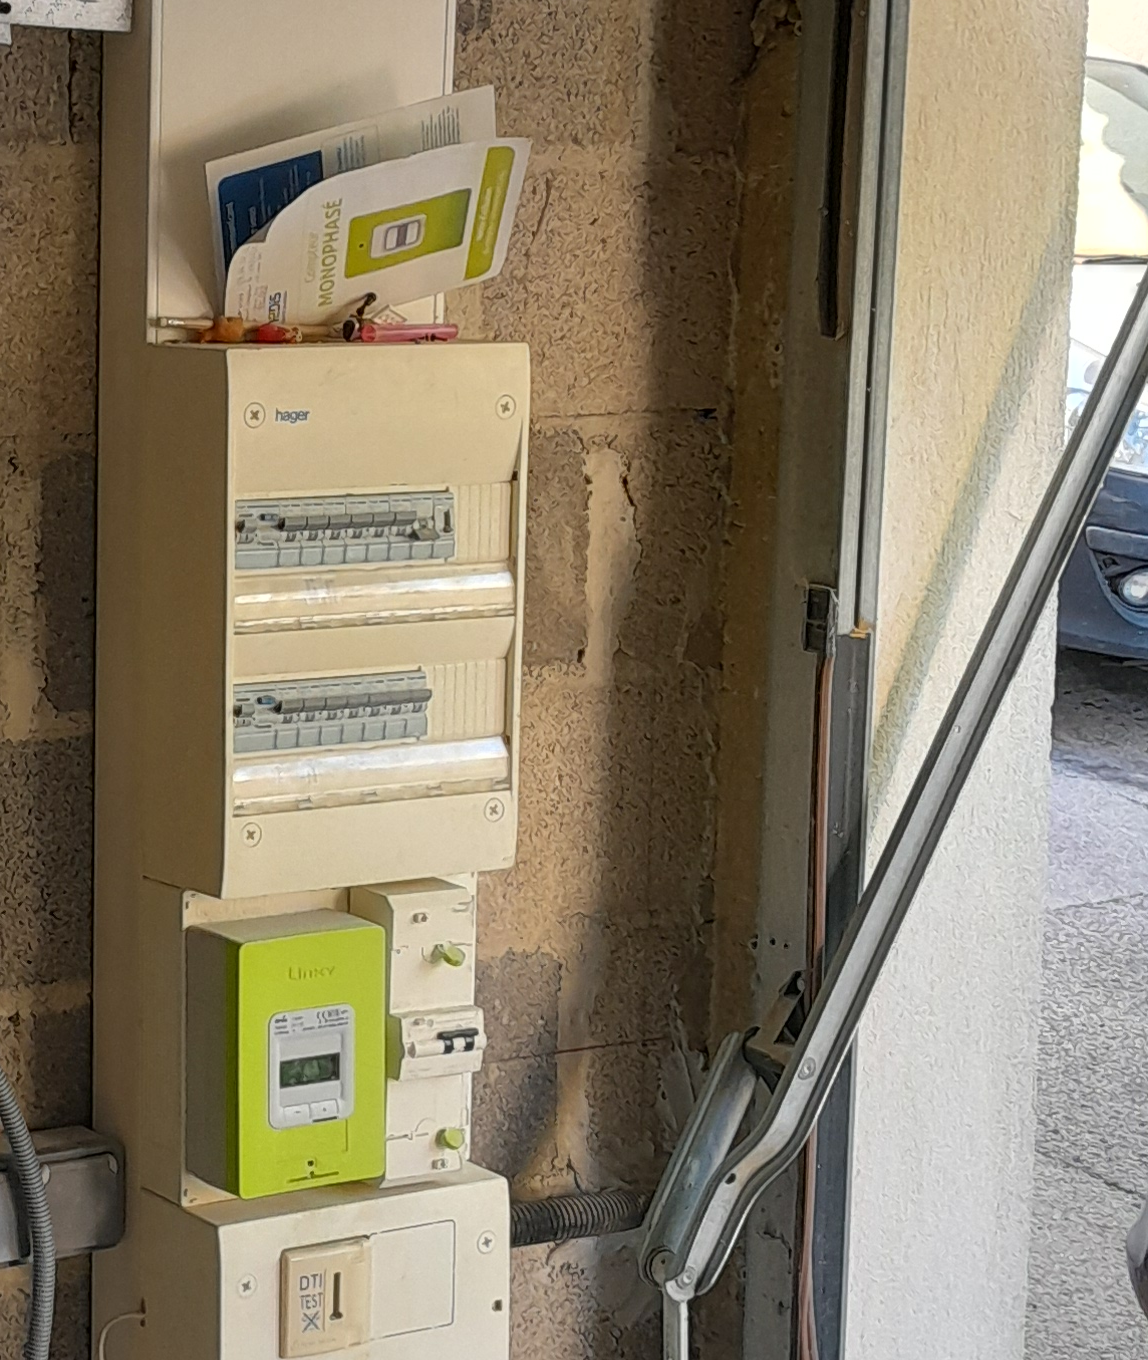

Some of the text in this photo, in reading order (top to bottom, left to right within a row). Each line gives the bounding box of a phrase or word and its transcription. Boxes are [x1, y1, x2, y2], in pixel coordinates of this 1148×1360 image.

[318, 198, 342, 308] MONOPHASÉ
[274, 407, 311, 424] hager
[299, 1272, 323, 1291] DTI
[299, 1292, 324, 1310] TEST
